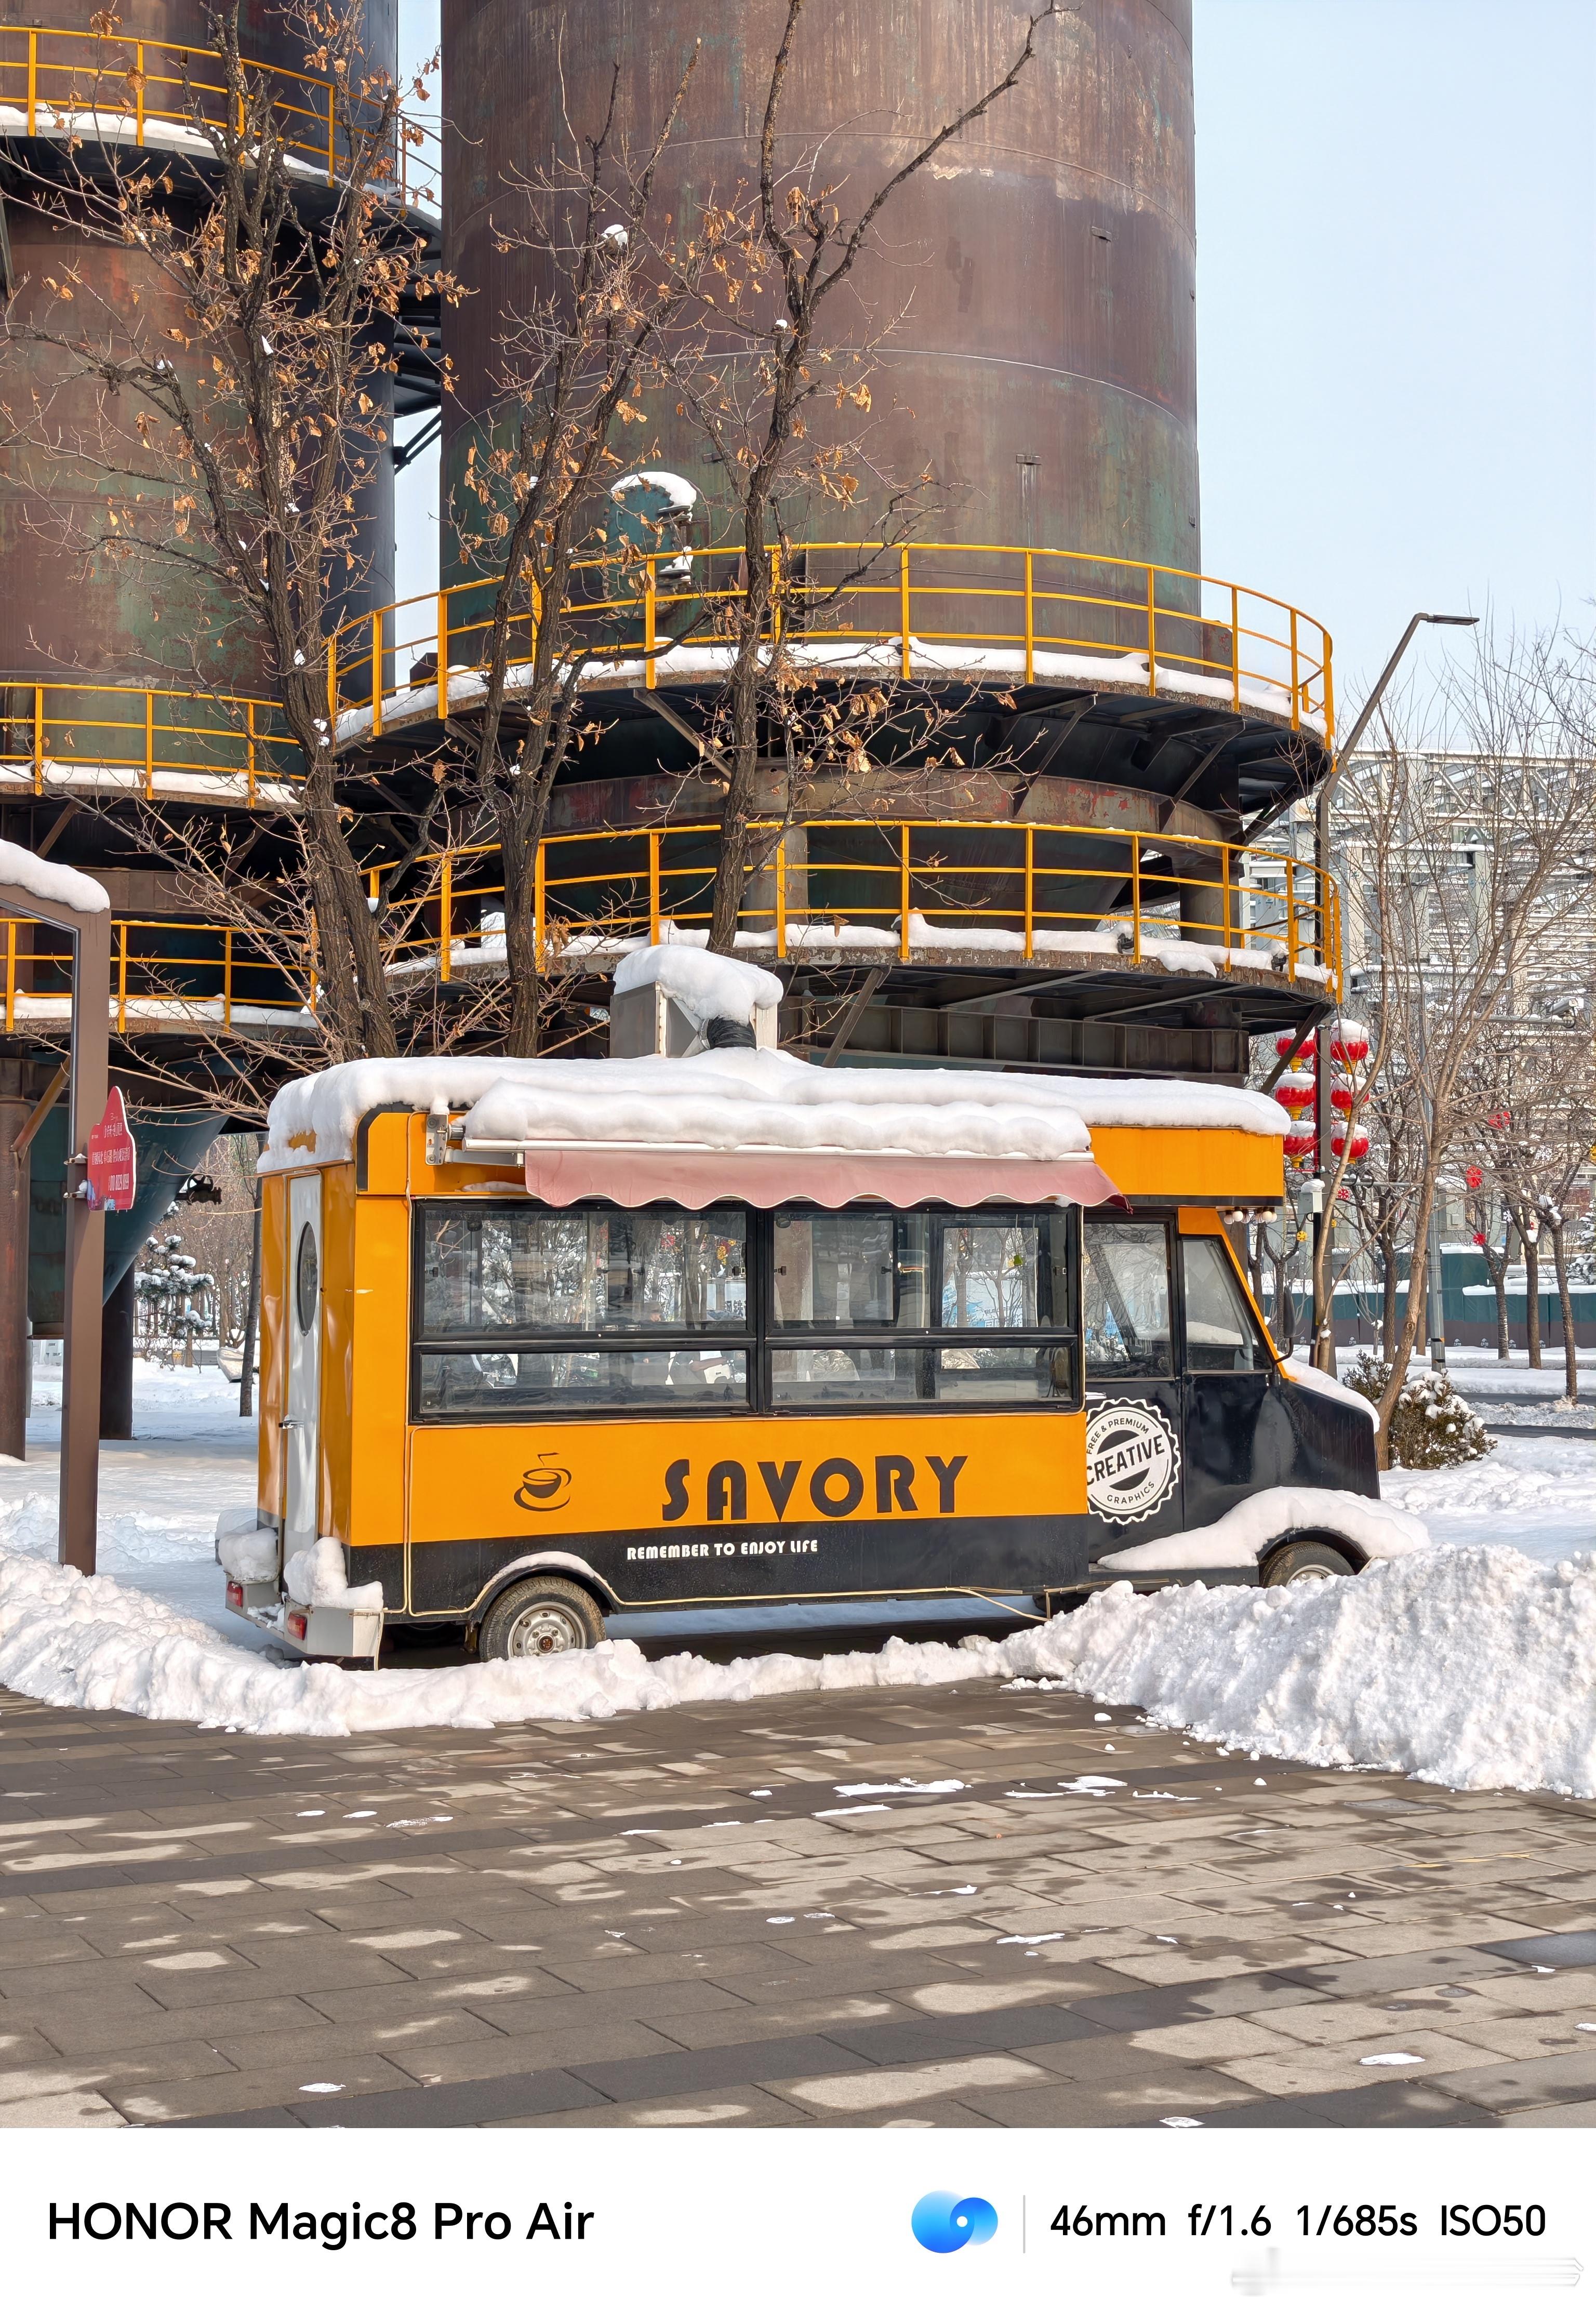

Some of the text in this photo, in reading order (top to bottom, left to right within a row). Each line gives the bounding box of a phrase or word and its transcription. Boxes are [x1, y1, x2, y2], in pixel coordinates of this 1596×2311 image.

[1086, 1430, 1101, 1455] FREE
[1108, 1417, 1149, 1434] PREMIUM
[662, 1455, 968, 1522] SAVORY
[1107, 1481, 1154, 1504] GRAPHICS
[627, 1539, 818, 1560] REMEMBER TO ENJOY LIFE
